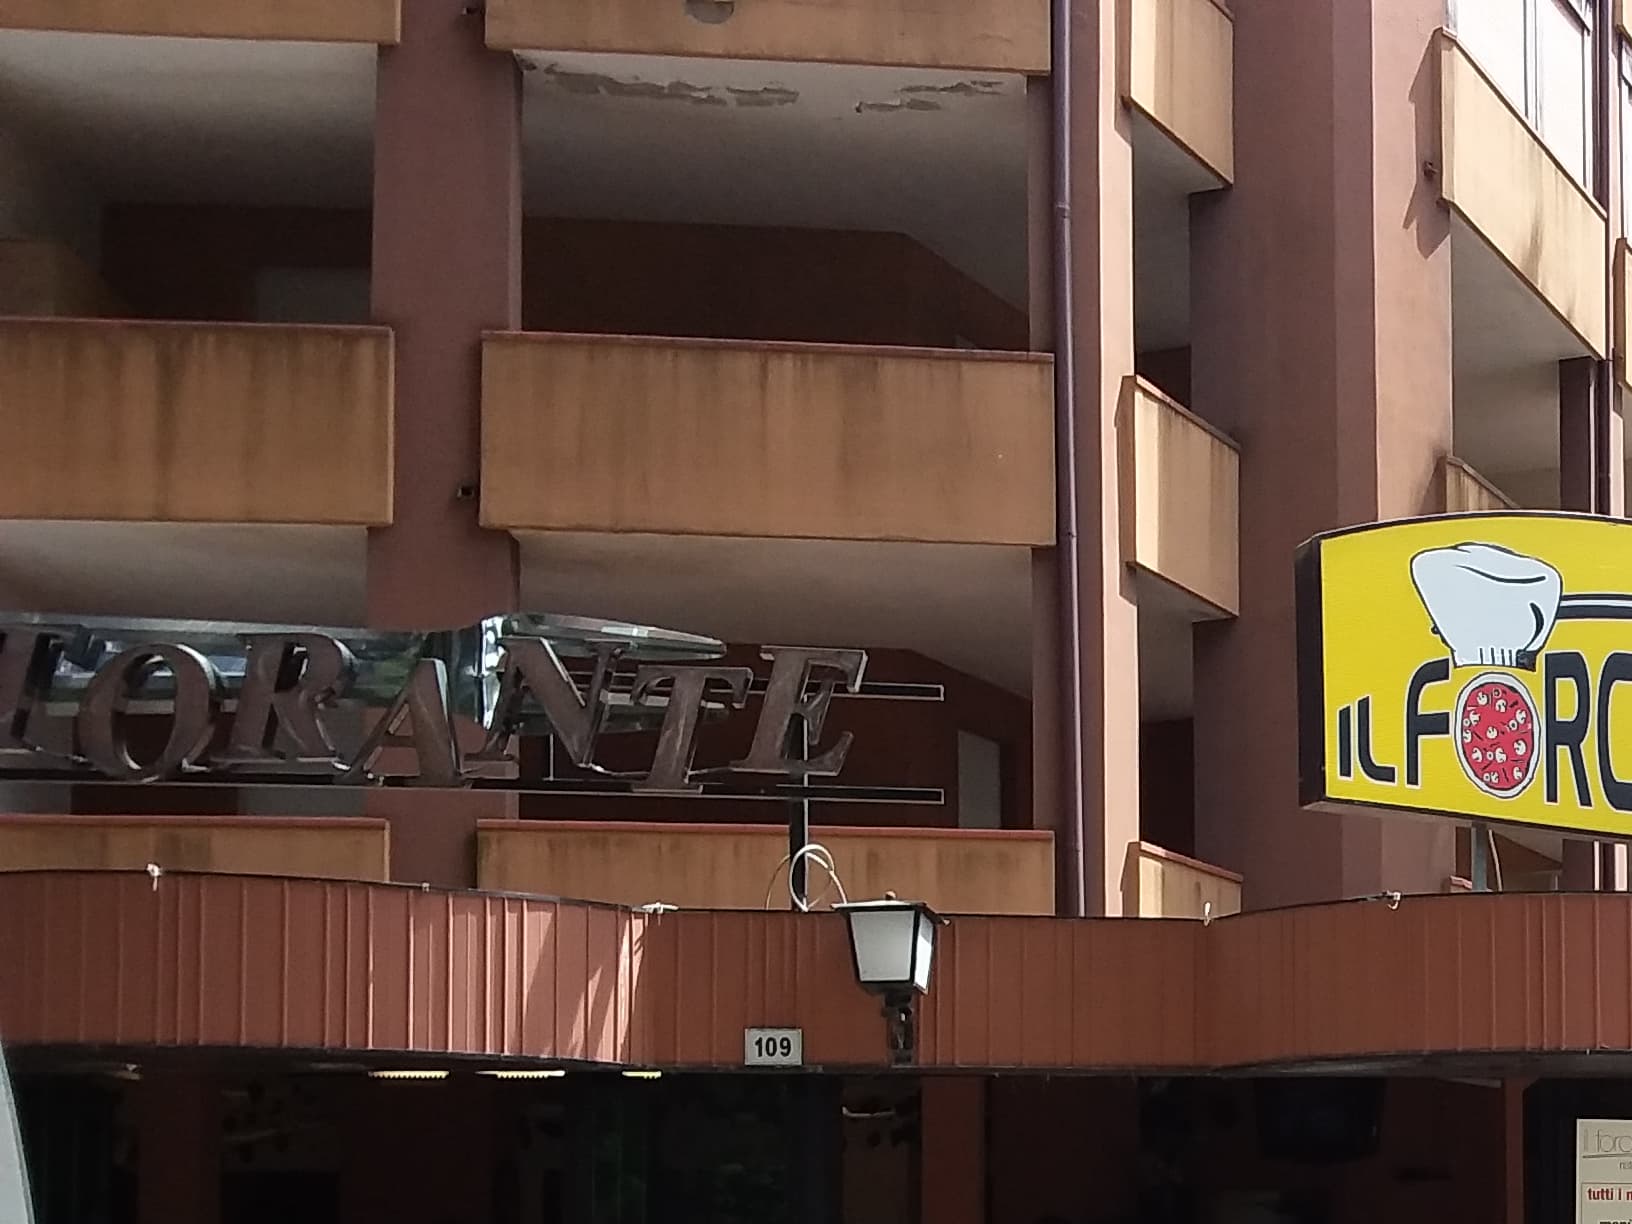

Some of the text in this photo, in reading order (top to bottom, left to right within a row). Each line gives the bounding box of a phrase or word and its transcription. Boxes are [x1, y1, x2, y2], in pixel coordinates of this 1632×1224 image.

[1337, 694, 1397, 784] IL
[755, 1036, 792, 1058] 109
[1587, 1187, 1614, 1201] tutti
